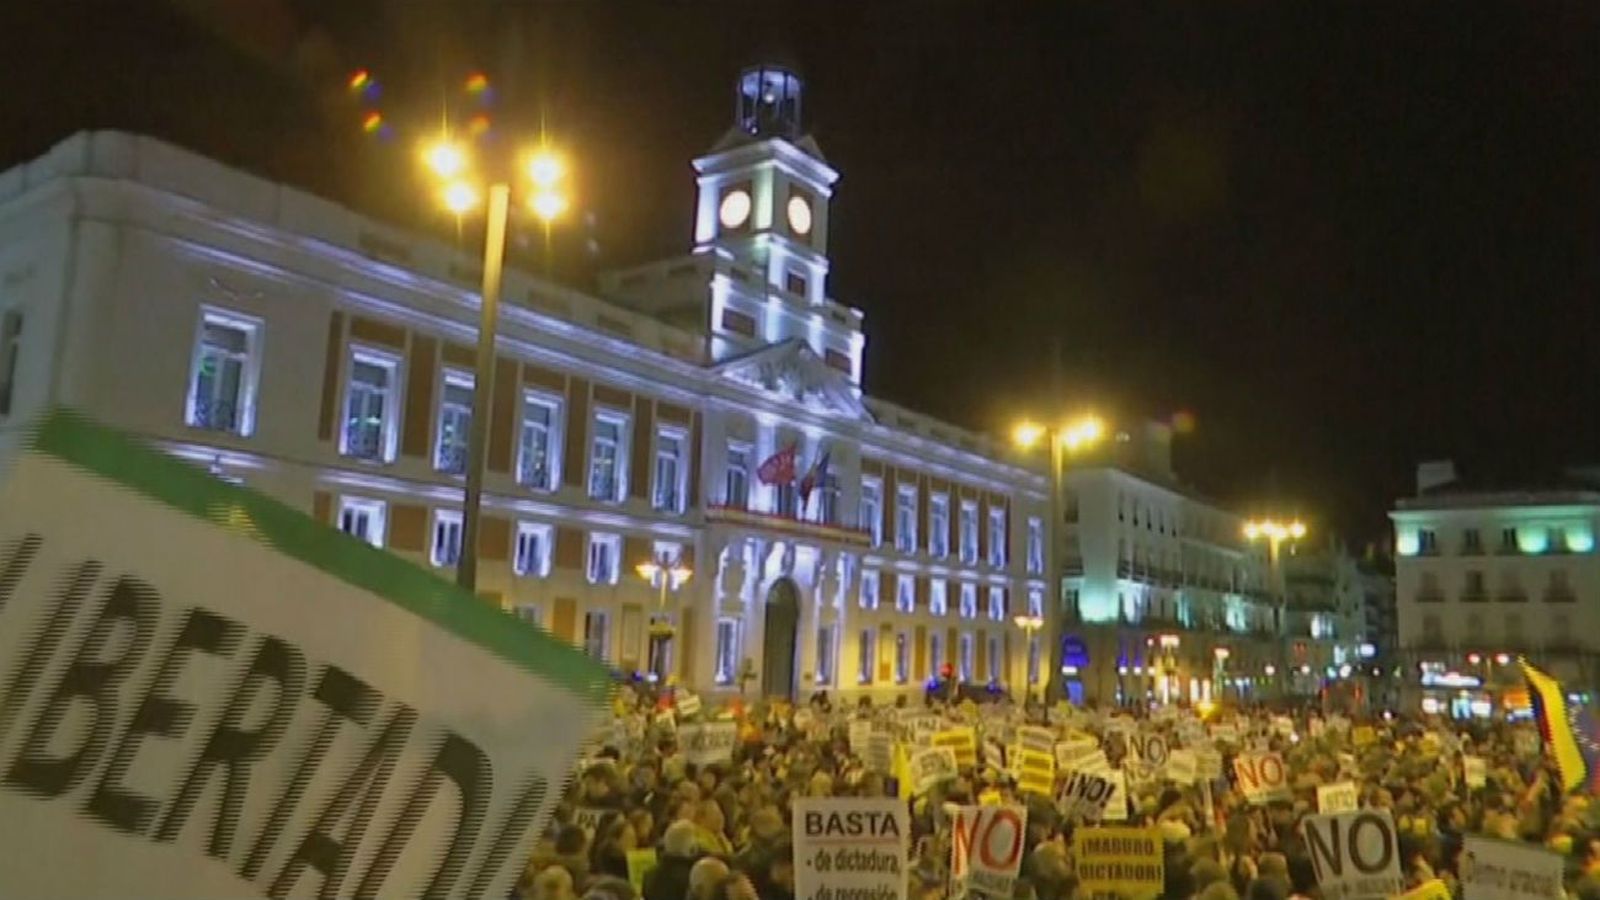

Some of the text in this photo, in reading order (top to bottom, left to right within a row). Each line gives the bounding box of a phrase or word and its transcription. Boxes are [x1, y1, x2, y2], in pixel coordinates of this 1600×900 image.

[1130, 735, 1163, 763] NO
[1237, 756, 1283, 788] NO
[805, 811, 900, 836] BASTA
[954, 810, 1023, 875] NO
[1304, 813, 1393, 882] NO
[815, 848, 832, 872] de
